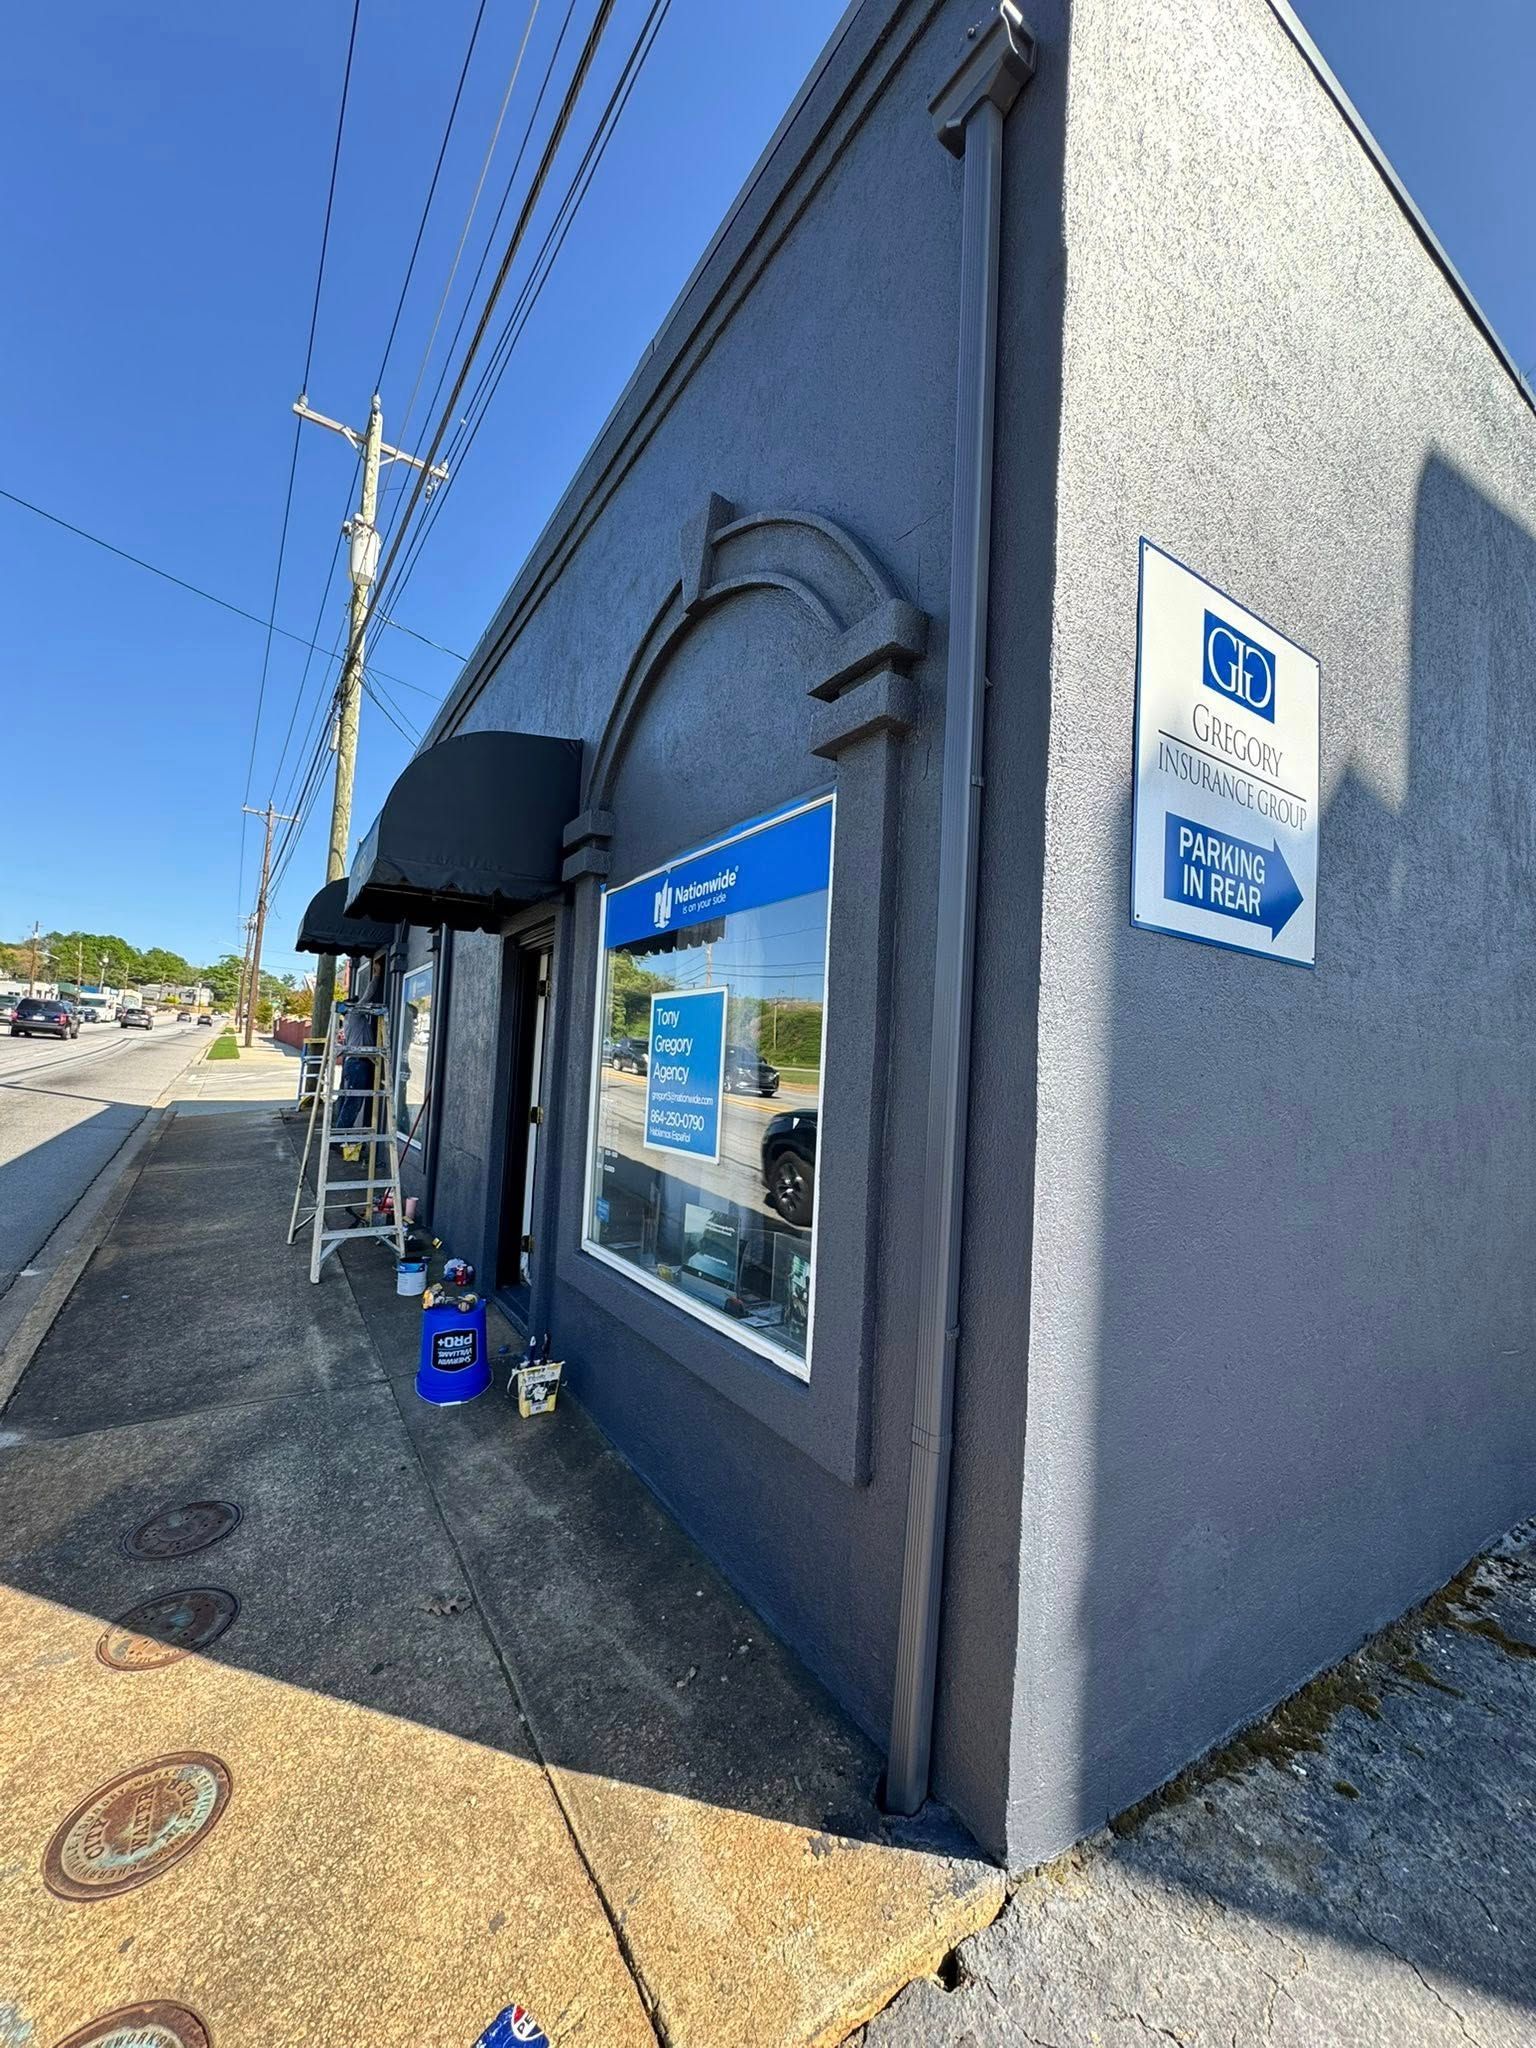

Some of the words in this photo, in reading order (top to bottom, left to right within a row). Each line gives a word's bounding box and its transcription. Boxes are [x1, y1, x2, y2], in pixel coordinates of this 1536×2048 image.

[1193, 704, 1283, 778] GREGORY
[1158, 742, 1254, 809] INSURANCE
[1257, 789, 1307, 831] GROUP
[1179, 826, 1265, 884] PARKING
[1183, 864, 1204, 900] IN
[1210, 872, 1261, 917] REAR
[682, 904, 688, 915] is
[688, 901, 697, 913] on
[697, 898, 712, 912] your
[713, 892, 727, 906] side
[657, 1008, 680, 1028] Tony
[655, 1035, 693, 1056] Gregory
[653, 1062, 690, 1085] Agency
[650, 1109, 705, 1131] 864-250-0790
[672, 1130, 691, 1143] Español
[437, 1333, 473, 1348] PRO+
[130, 1786, 156, 1854] WATER
[84, 1818, 109, 1860] CITY
